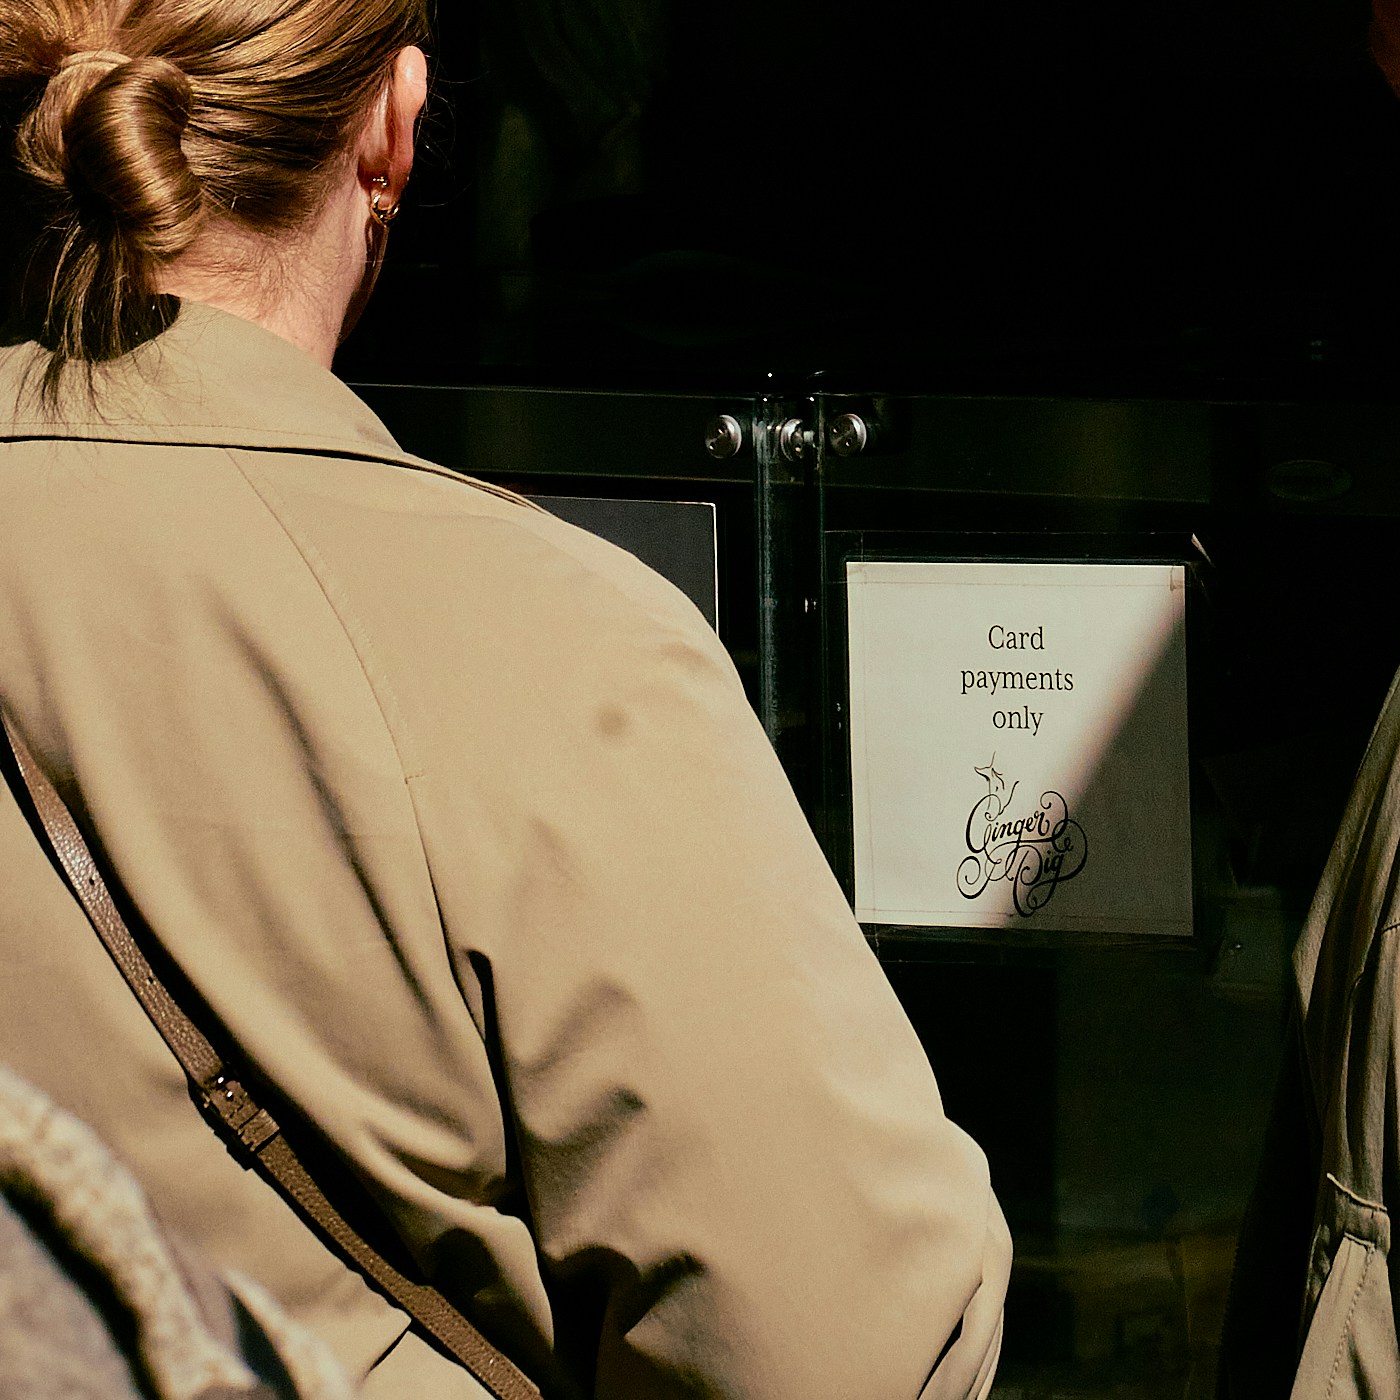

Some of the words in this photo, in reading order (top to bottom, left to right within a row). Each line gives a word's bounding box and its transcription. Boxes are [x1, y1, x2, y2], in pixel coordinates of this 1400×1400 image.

[988, 625, 1045, 650] Card
[960, 668, 1074, 695] payments
[992, 705, 1044, 736] only
[965, 791, 1069, 864] Ginger
[1013, 843, 1088, 918] Pig
